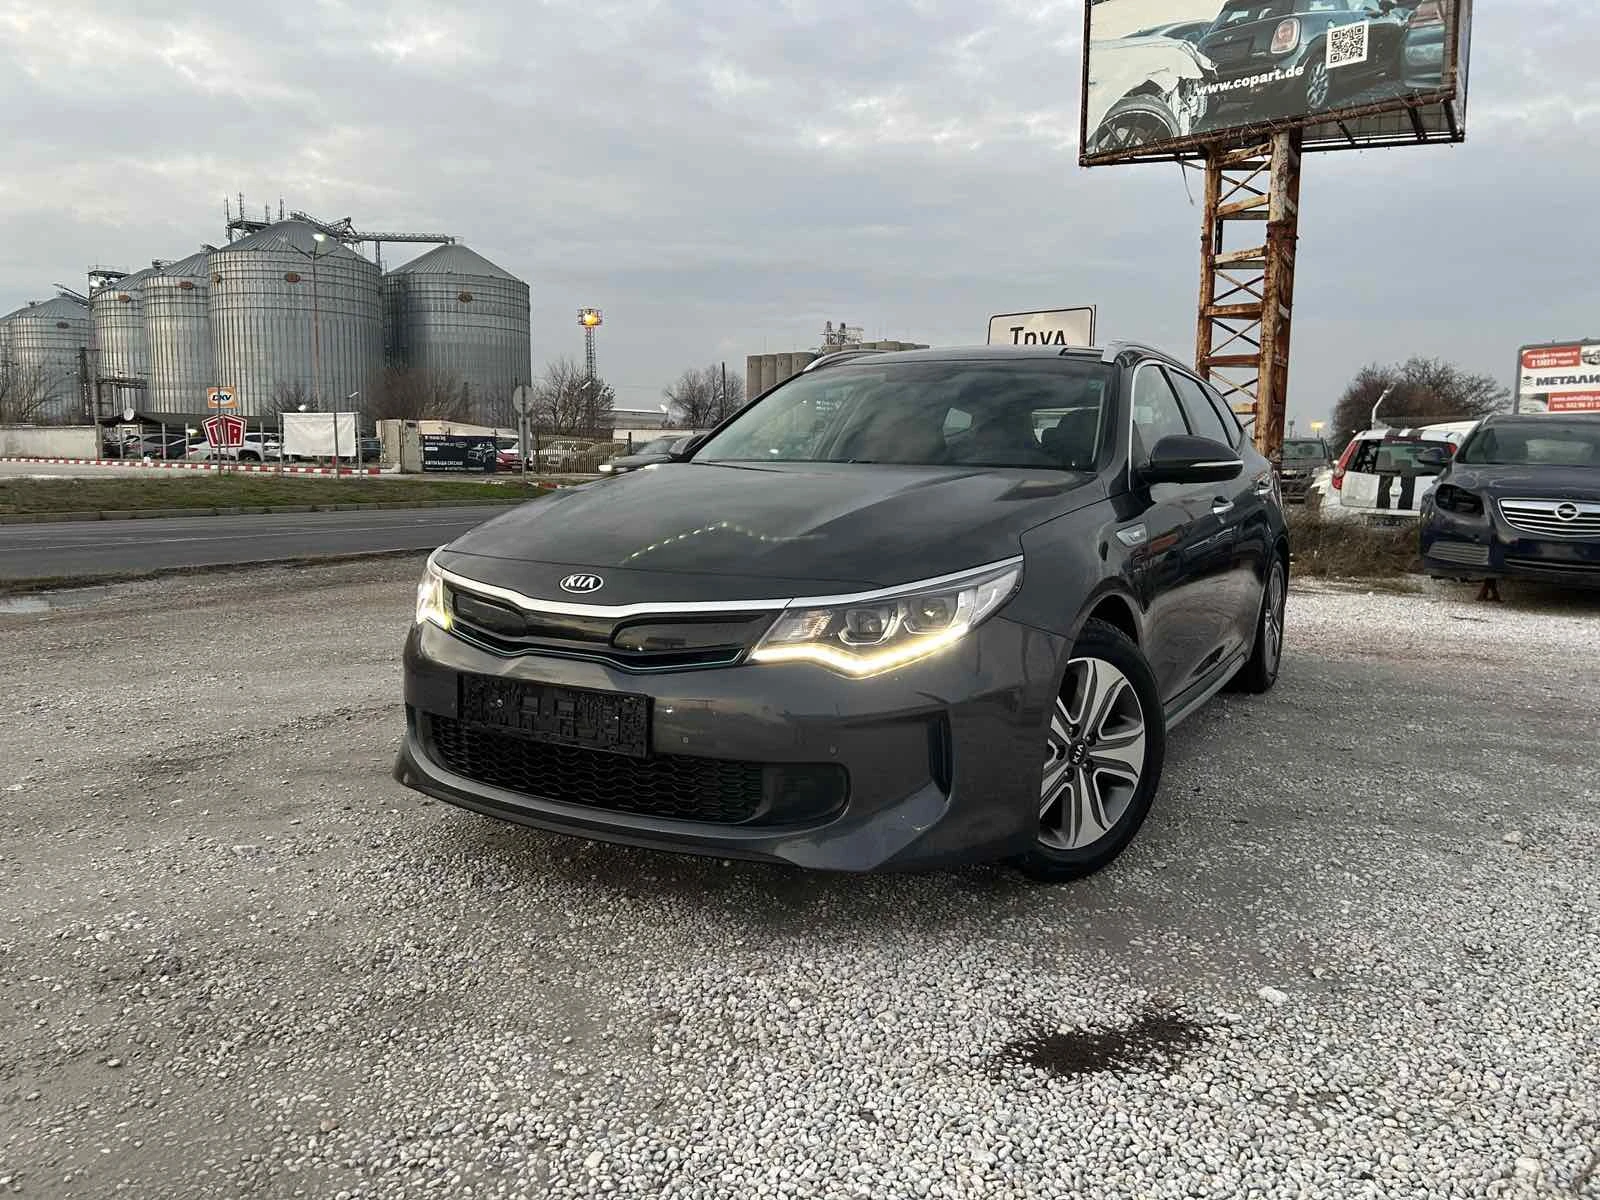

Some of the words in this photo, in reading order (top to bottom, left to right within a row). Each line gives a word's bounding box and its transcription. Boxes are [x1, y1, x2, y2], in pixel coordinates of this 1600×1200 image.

[1196, 65, 1304, 96] www.copart.de
[565, 575, 596, 589] KIA
[1072, 744, 1084, 764] KIA
